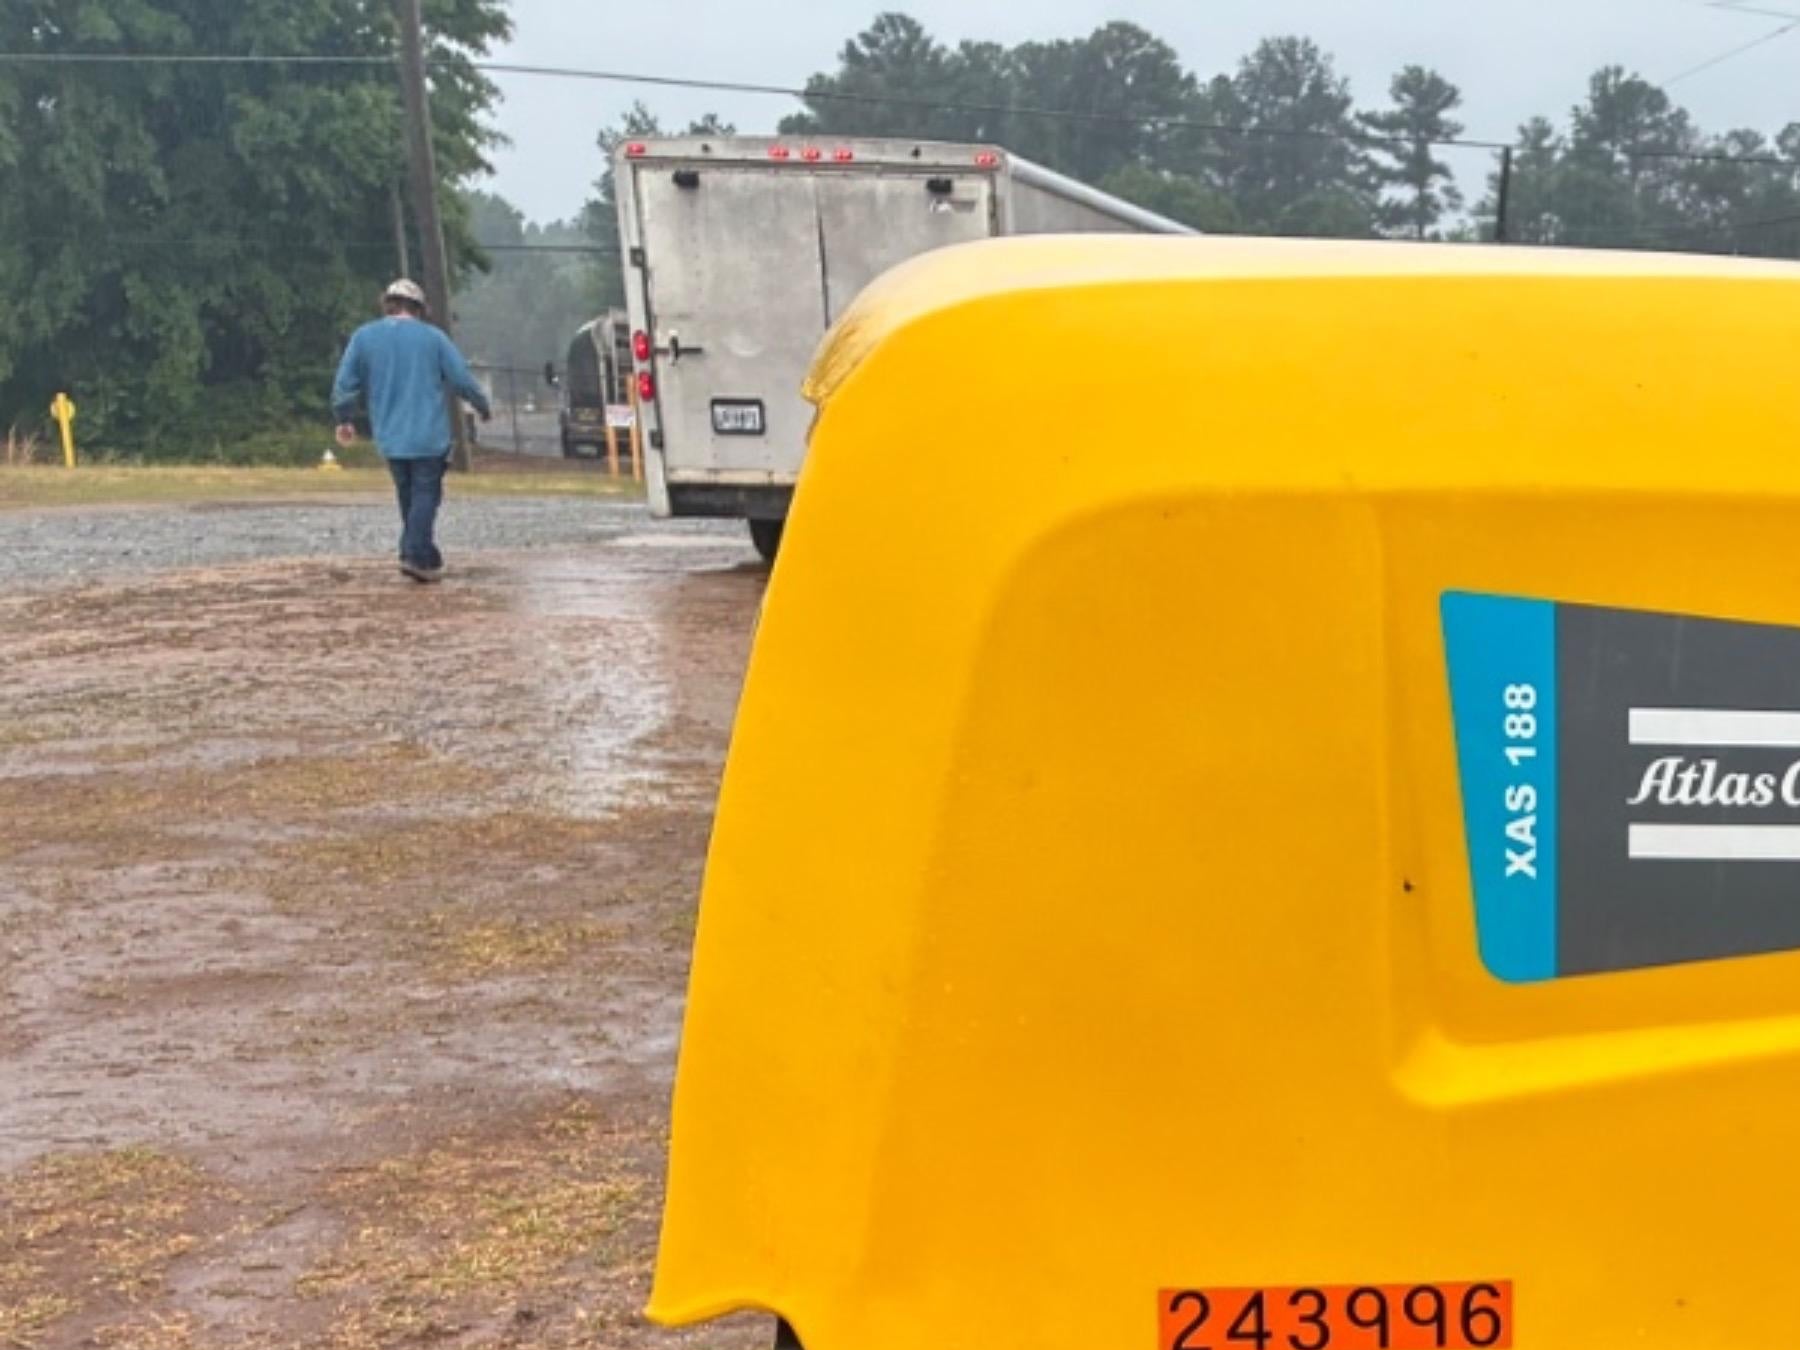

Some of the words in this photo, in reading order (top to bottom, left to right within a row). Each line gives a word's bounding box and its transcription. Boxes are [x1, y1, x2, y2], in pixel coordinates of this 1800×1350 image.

[1504, 683, 1537, 765] 188
[1627, 756, 1777, 807] Atlas
[1505, 785, 1537, 878] XAS
